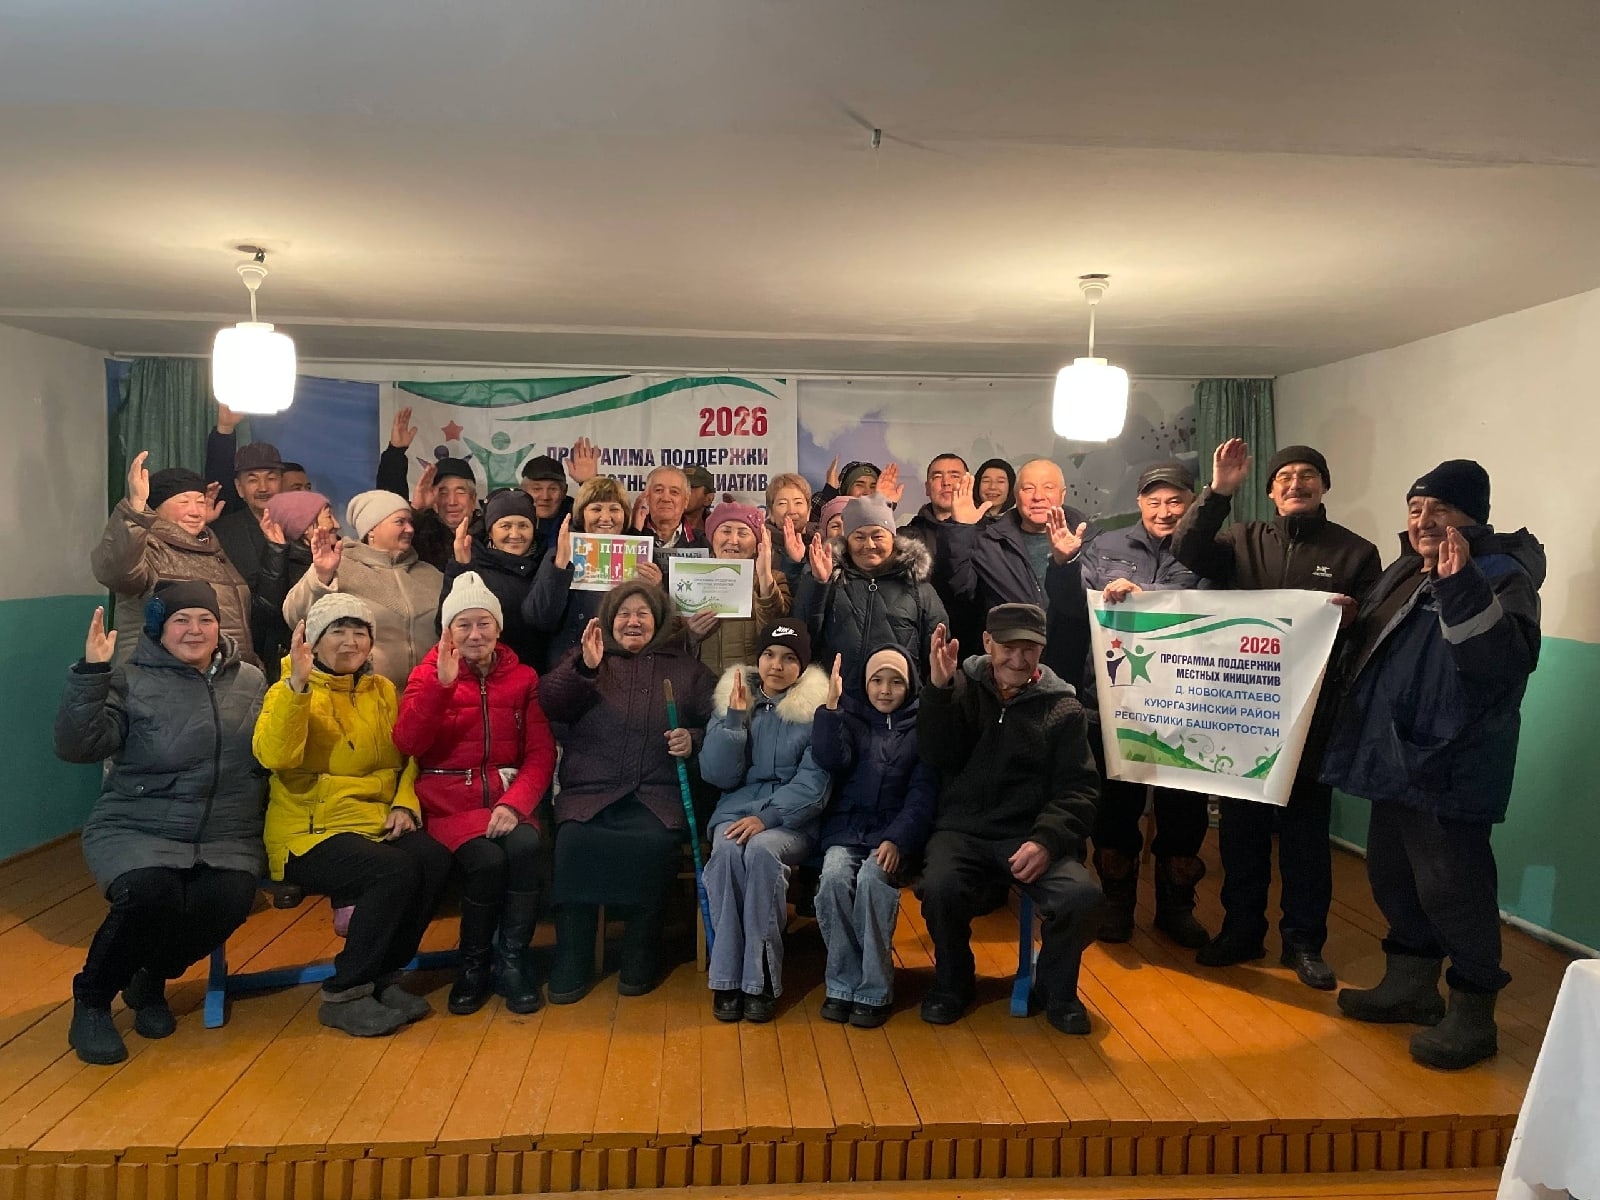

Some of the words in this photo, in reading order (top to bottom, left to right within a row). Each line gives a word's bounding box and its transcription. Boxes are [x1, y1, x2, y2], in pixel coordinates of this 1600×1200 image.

[699, 406, 768, 437] 2026
[546, 446, 656, 466] ПРАММА
[660, 448, 768, 467] ПОДДЕРЖКИ
[600, 543, 648, 555] ППМИ
[1240, 636, 1281, 655] 2026
[1160, 653, 1216, 667] ПРОГРАММА
[1218, 657, 1281, 672] ПОДДЕРЖКИ
[1176, 668, 1220, 682] МЕСТНЫХ
[1223, 672, 1281, 687] ИНИЦИАТИВ
[1175, 685, 1184, 695] Д.
[1188, 686, 1281, 703] НОВОКАЛТАЕВО
[1144, 697, 1237, 716] КУЮРГАЗИНСКИЙ
[1240, 705, 1281, 720] РАЙОН
[1114, 710, 1183, 727] РЕСПУБЛИКИ
[1186, 719, 1280, 738] БАШКОРТОСТАН
